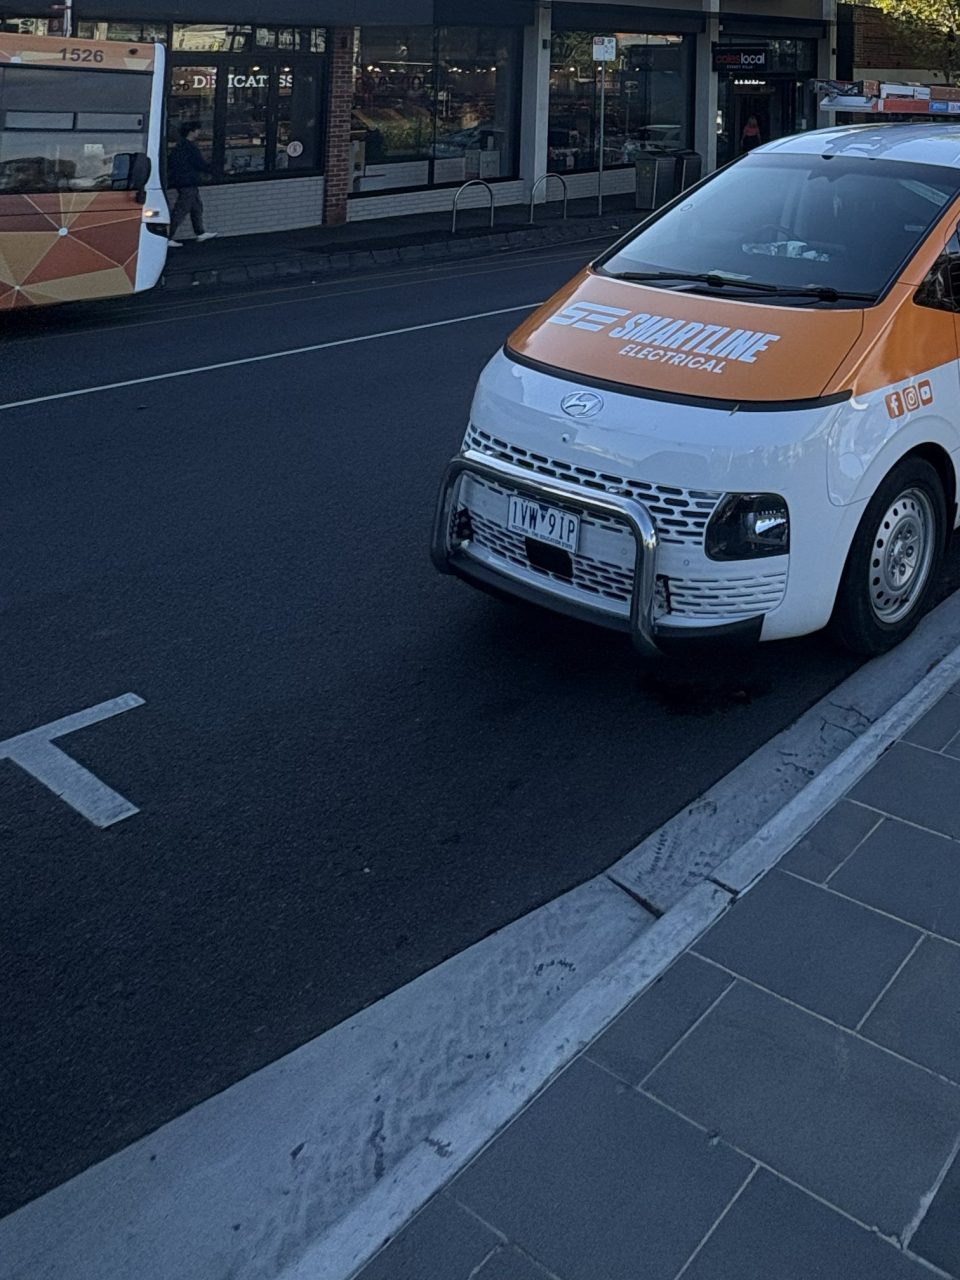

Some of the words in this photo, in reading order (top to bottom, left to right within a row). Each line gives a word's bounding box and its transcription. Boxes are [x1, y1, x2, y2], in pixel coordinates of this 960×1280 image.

[59, 47, 104, 63] 1526
[741, 52, 765, 64] local
[608, 313, 782, 363] SMARTLINE
[618, 344, 727, 374] ELECTRICAL
[512, 500, 539, 531] 1VW
